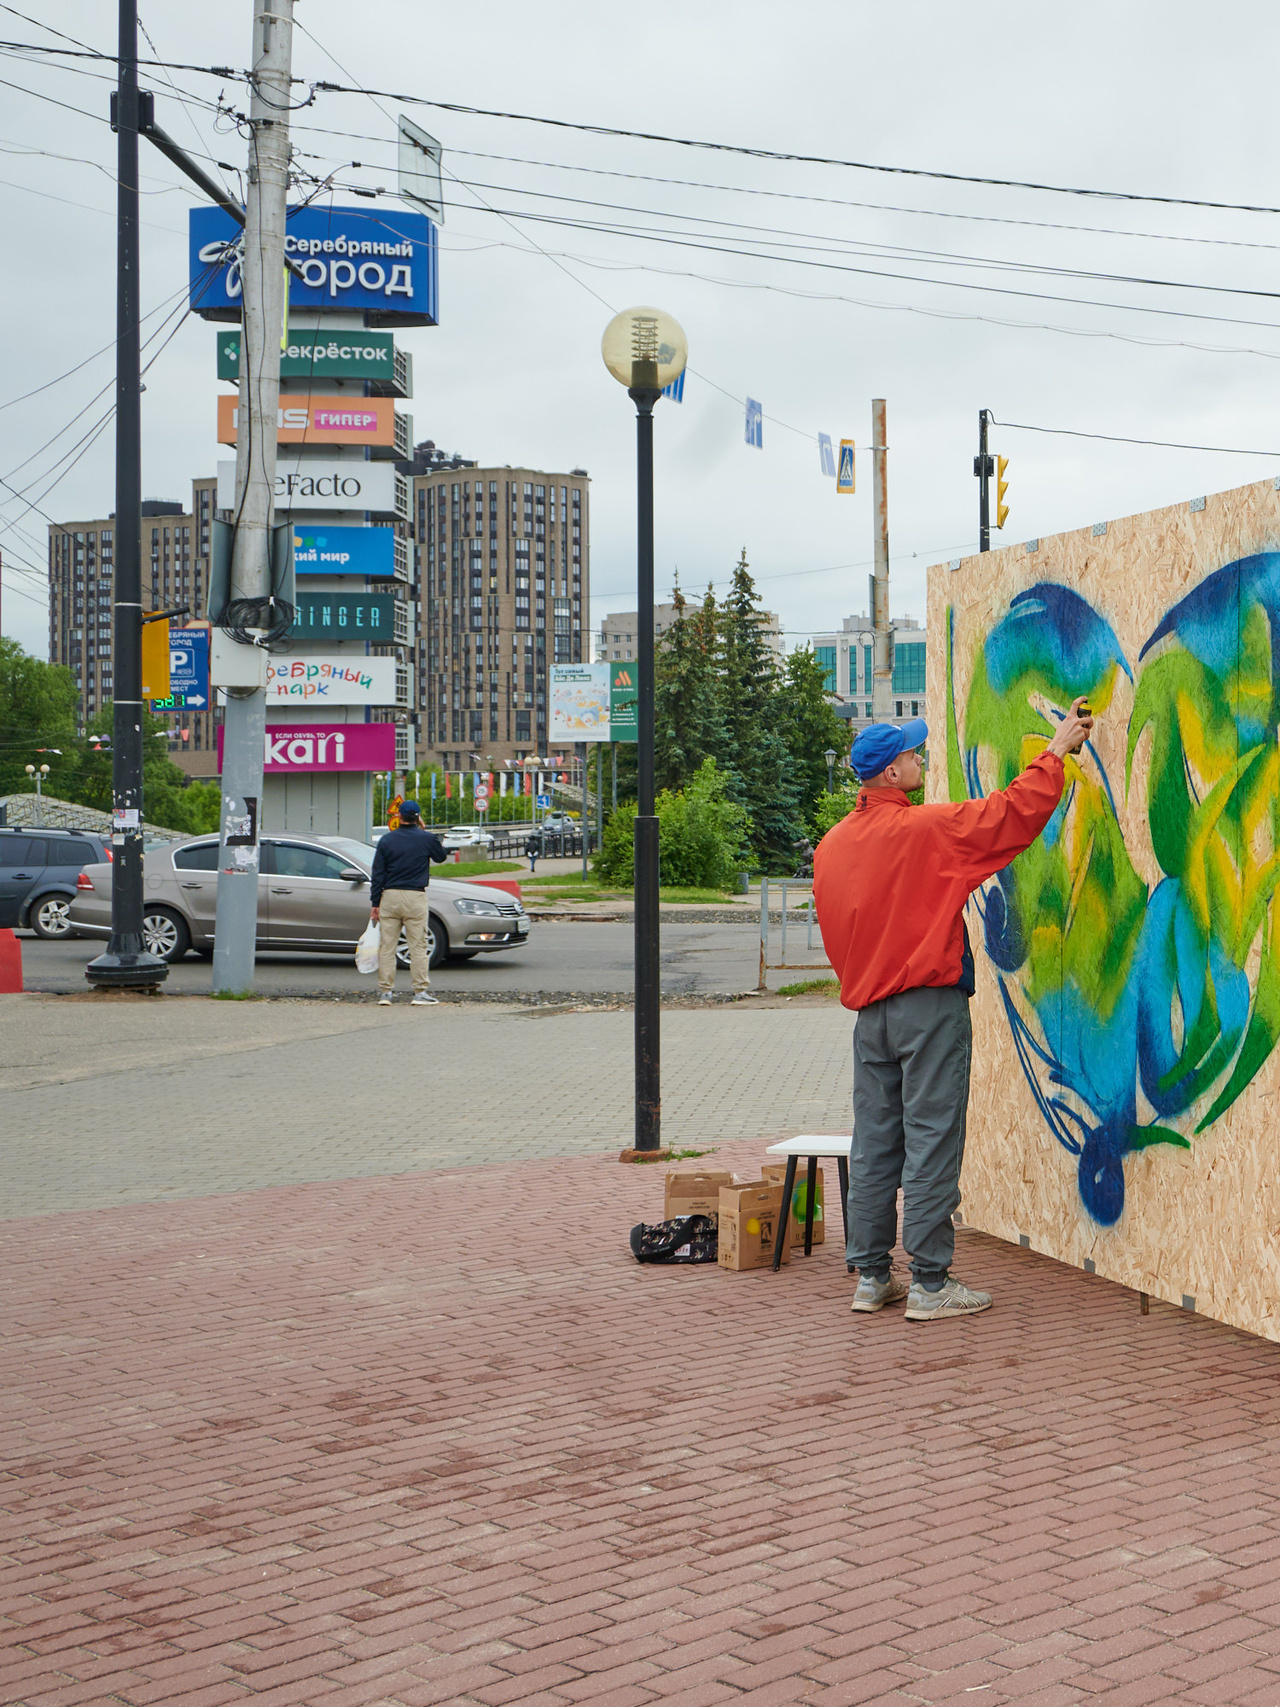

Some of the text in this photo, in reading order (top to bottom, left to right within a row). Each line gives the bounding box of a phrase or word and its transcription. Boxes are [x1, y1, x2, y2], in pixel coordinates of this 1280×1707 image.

[284, 235, 413, 257] Серебряный
[280, 343, 388, 362] екрёсток
[320, 413, 372, 426] ГИПЕР
[274, 473, 362, 497] eFacto
[320, 552, 350, 564] мир
[293, 606, 380, 627] RINGER
[277, 682, 329, 700] парк
[264, 732, 345, 764] kari
